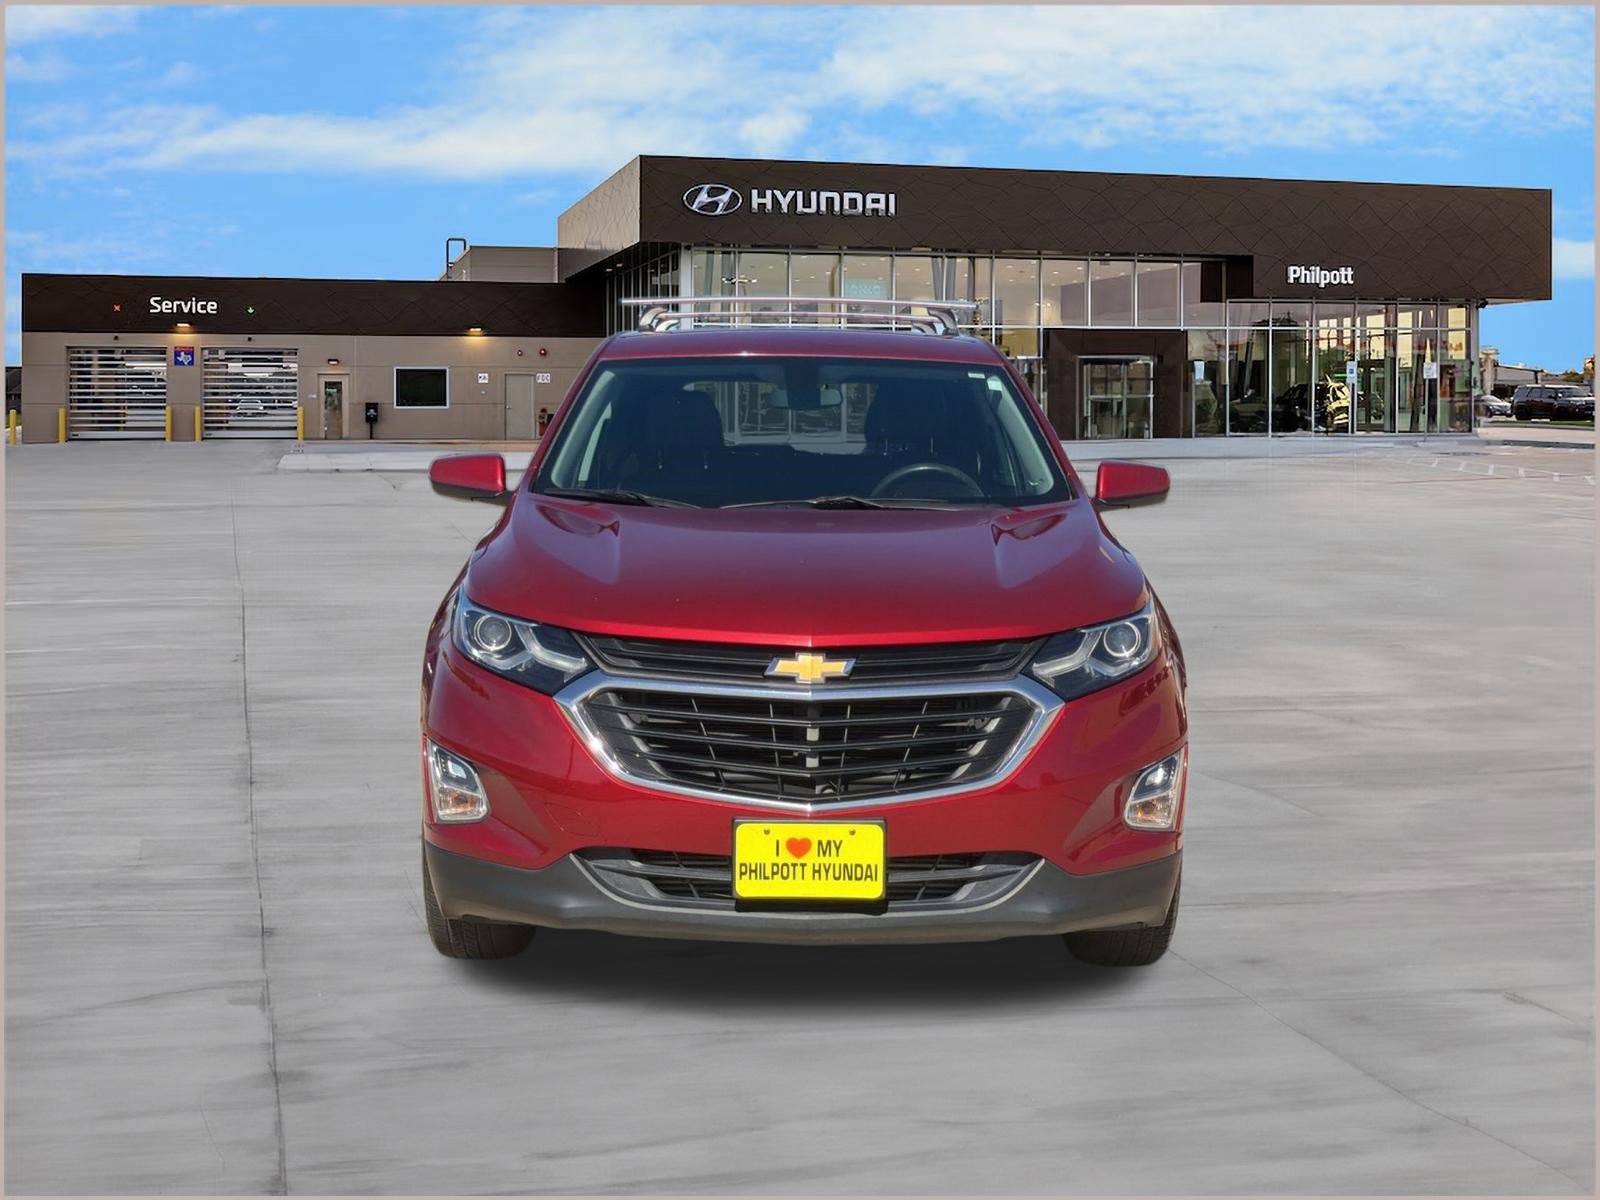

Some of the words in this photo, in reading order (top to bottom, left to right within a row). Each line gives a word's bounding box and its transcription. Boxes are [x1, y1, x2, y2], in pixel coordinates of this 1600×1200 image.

[750, 189, 897, 216] HYUNDAI
[1287, 265, 1355, 288] Philpott
[149, 297, 218, 315] Service
[775, 839, 780, 857] I
[817, 839, 843, 857] MY
[738, 862, 808, 881] PHILPOTT
[812, 863, 879, 882] HYUNDAI
